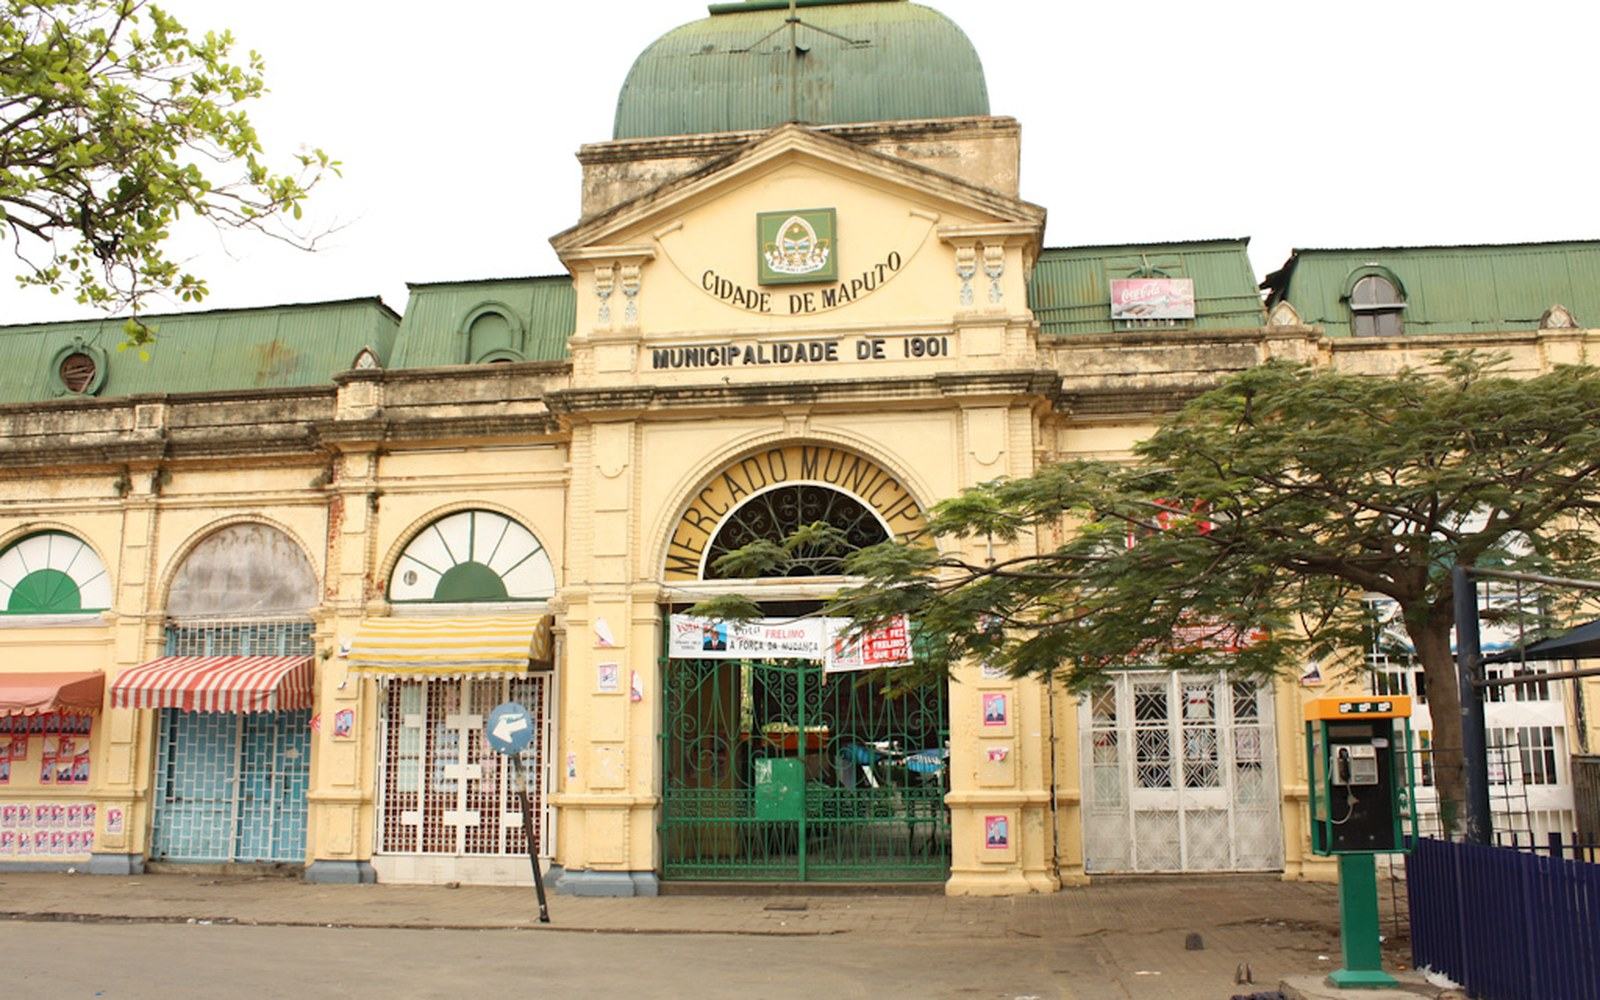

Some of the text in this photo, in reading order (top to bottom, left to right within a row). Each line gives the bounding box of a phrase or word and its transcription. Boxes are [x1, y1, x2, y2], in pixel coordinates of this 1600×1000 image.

[702, 251, 901, 314] CIDADE DE MAPUTO
[652, 336, 948, 370] MUNICIPALIDADE DE 1901
[664, 446, 924, 576] MERCADO MUNICIPA
[765, 627, 806, 640] FRELIMO
[872, 639, 905, 650] FRELIMO
